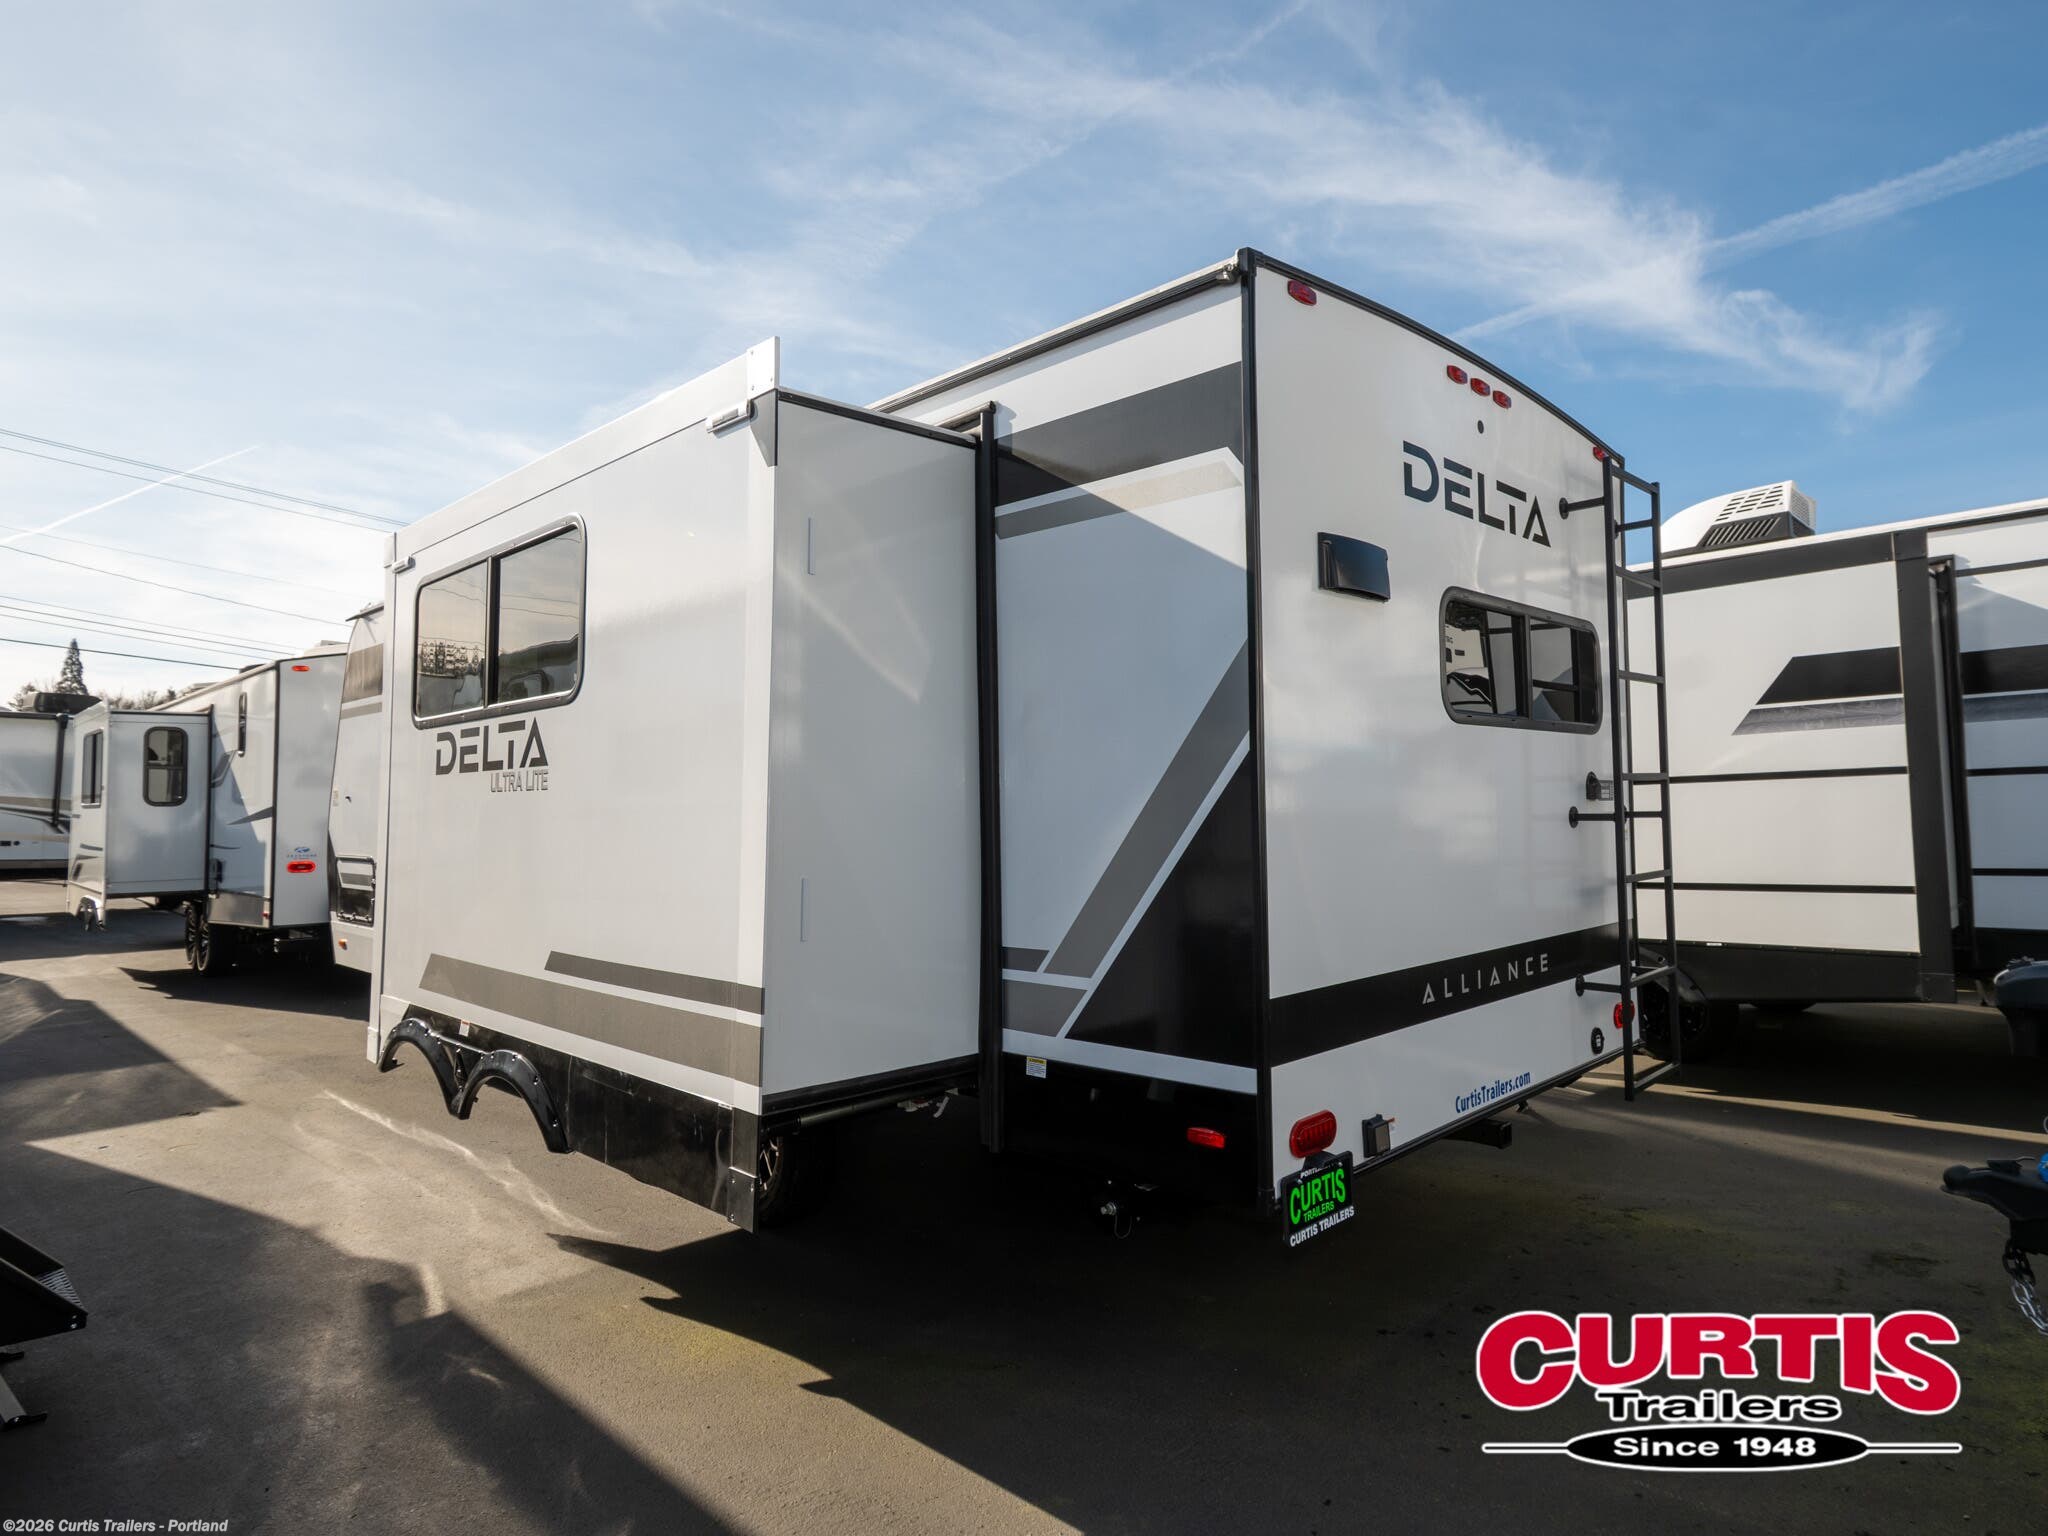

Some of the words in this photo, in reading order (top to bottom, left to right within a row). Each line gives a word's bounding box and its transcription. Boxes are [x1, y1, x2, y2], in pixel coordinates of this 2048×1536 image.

[1403, 440, 1551, 548] DELTA
[436, 717, 548, 775] DELTA
[490, 771, 523, 793] ULTRA
[525, 769, 549, 791] LITE
[1422, 953, 1550, 1005] ALLIANCE
[1455, 1071, 1531, 1114] CurtisTrailers.com
[1290, 1169, 1346, 1224] CURTIS
[1304, 1202, 1334, 1222] TRAILERS
[1290, 1225, 1318, 1247] CURTIS
[1320, 1206, 1354, 1231] TRAILERS
